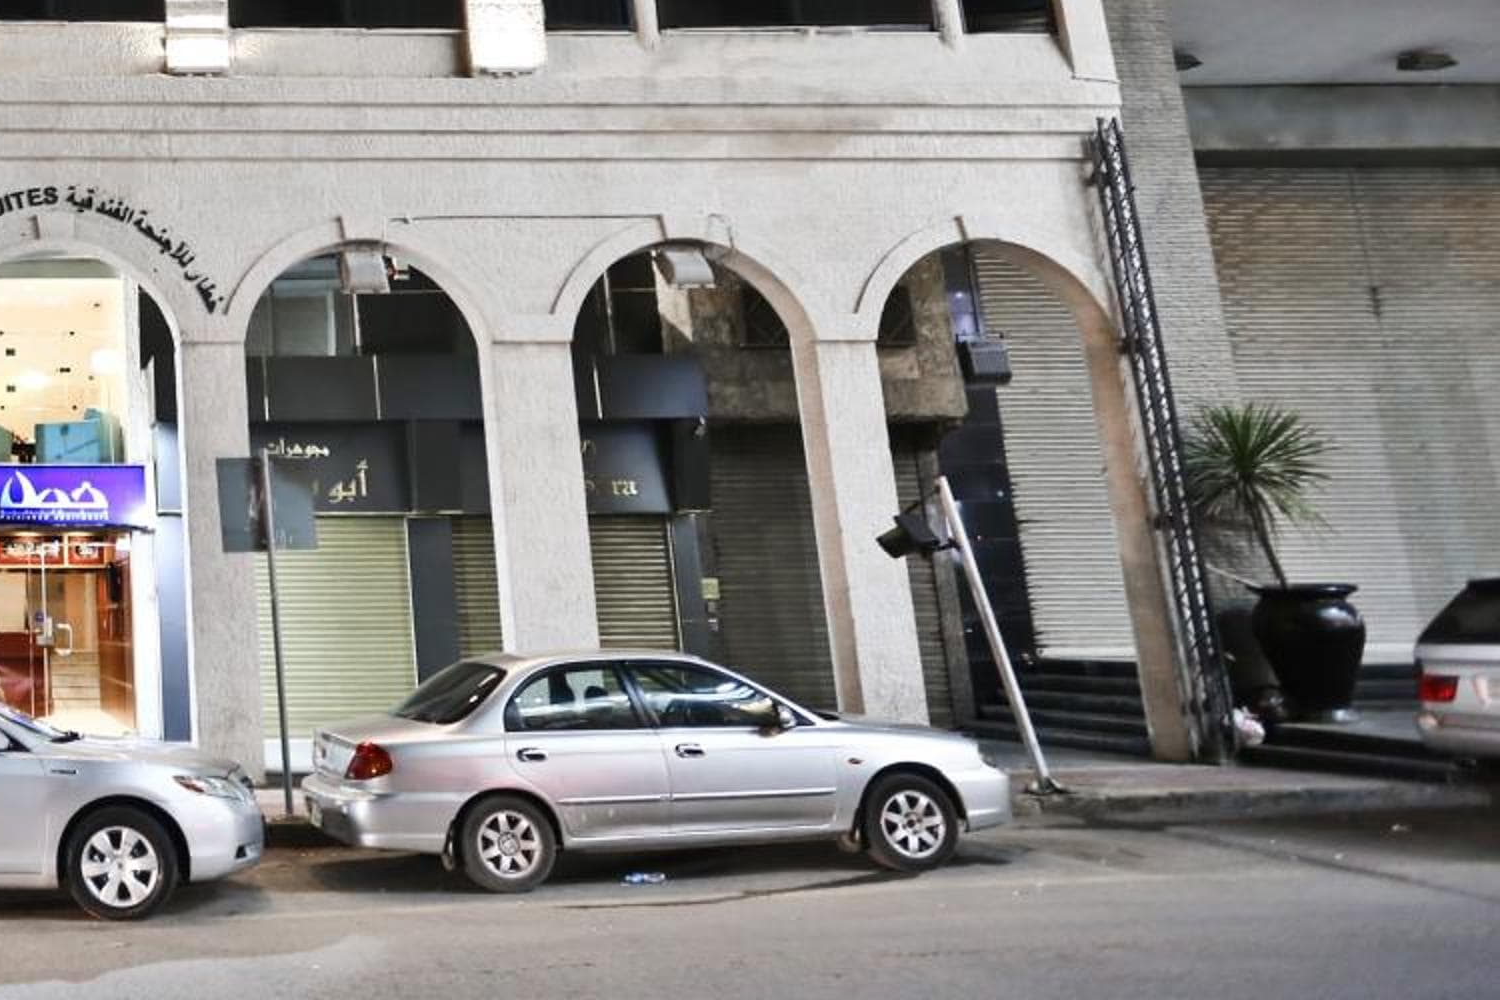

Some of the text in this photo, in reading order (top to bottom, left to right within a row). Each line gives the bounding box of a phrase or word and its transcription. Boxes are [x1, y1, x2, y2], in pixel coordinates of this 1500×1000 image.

[66, 185, 134, 223] الفندقية
[184, 271, 224, 314] خطار
[266, 437, 330, 459] مجوهرات
[328, 458, 369, 503] أبو
